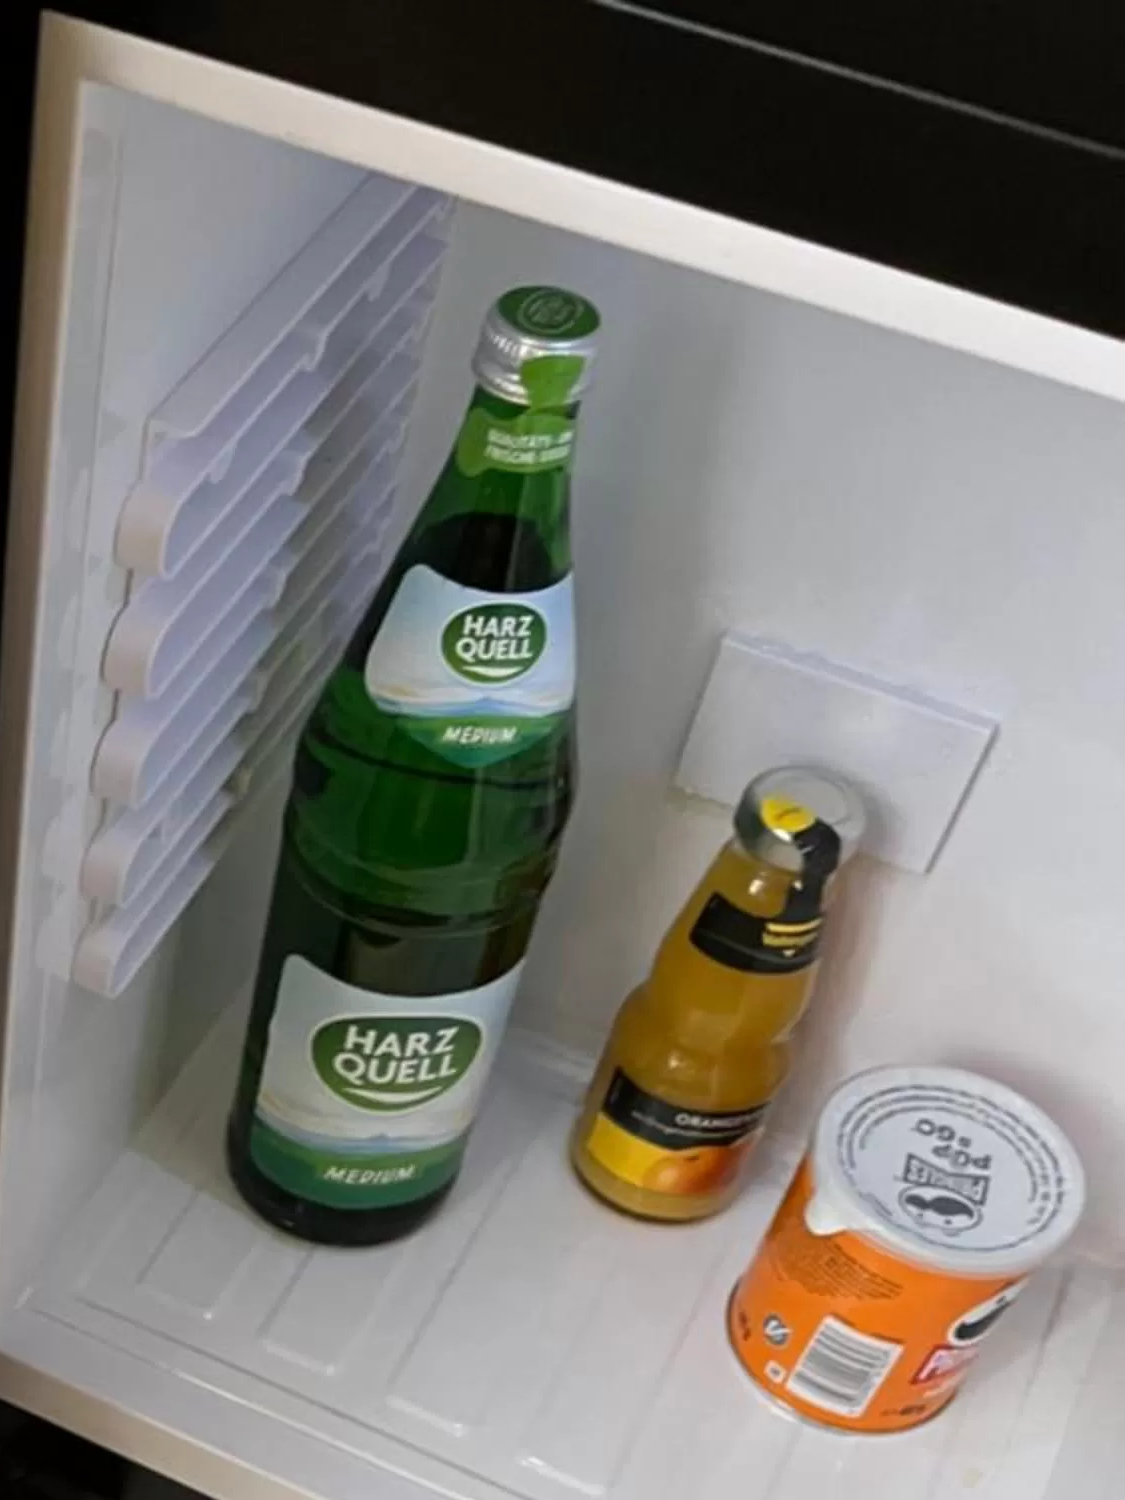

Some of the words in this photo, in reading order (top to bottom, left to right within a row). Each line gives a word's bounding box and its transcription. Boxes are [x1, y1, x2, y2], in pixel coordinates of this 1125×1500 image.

[463, 615, 533, 639] HARZ
[456, 638, 533, 660] QUELL
[443, 726, 517, 743] MEDIUM
[345, 1025, 459, 1057] HARZ
[333, 1053, 457, 1085] QUELL
[324, 1164, 415, 1184] MEDIUM
